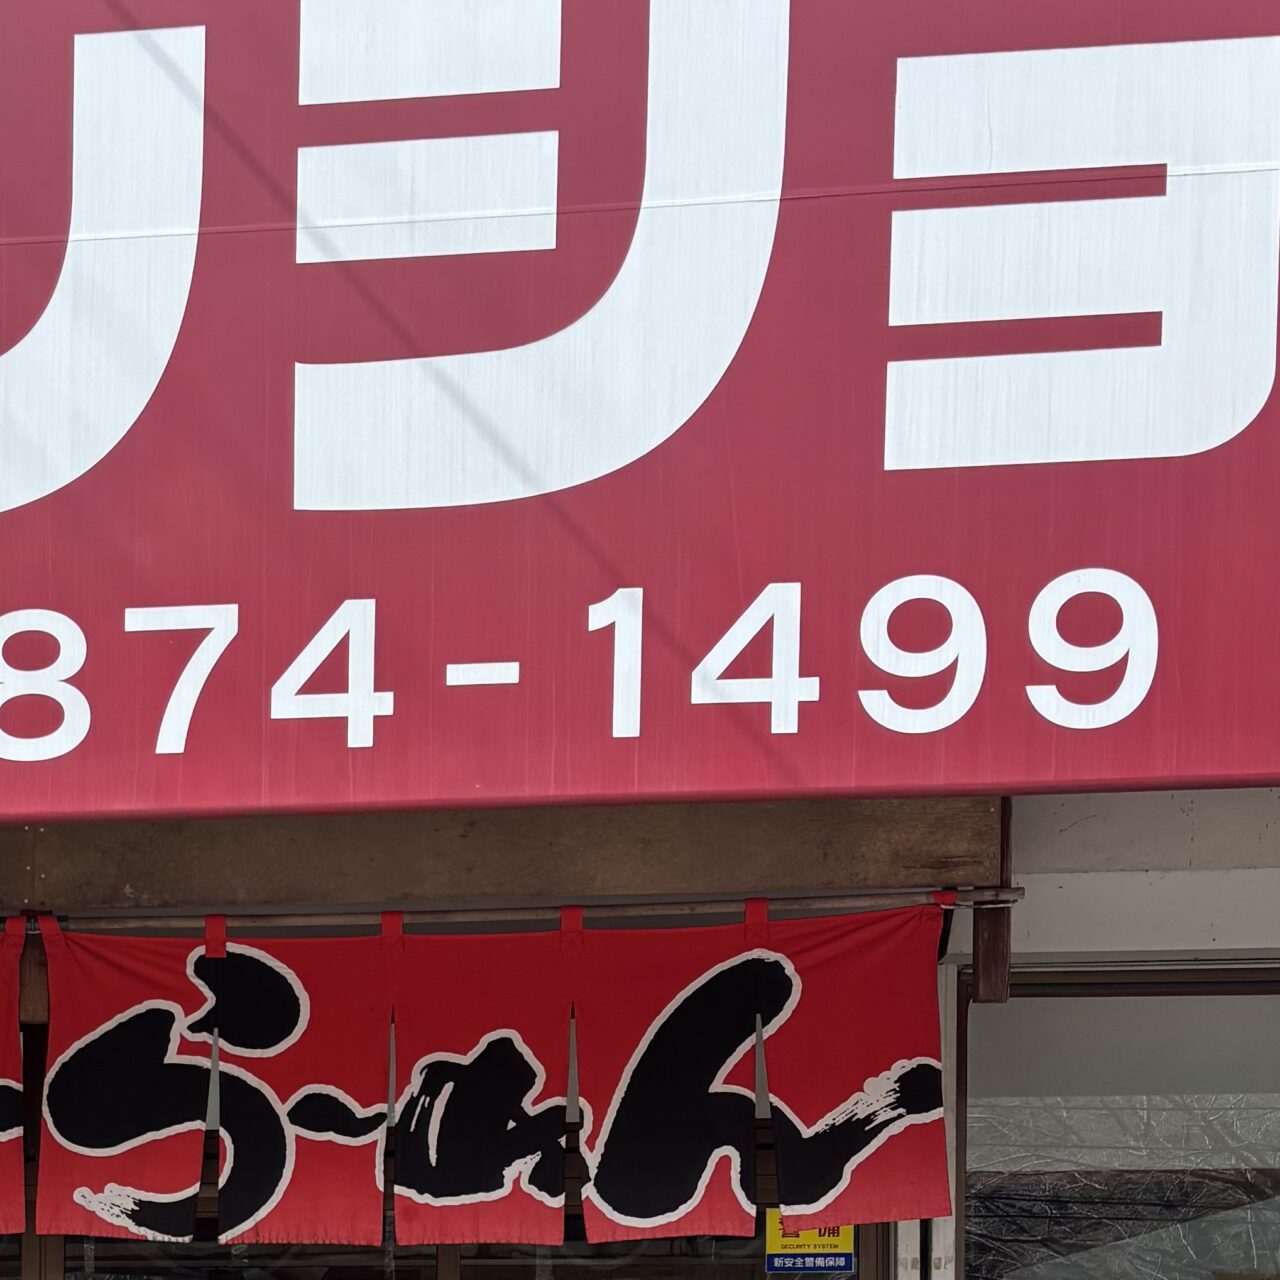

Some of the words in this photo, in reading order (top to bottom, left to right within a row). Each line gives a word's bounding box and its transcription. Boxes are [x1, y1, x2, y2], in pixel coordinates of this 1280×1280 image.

[42, 942, 946, 1244] らーめん
[773, 1256, 846, 1268] 新安全警備保障
